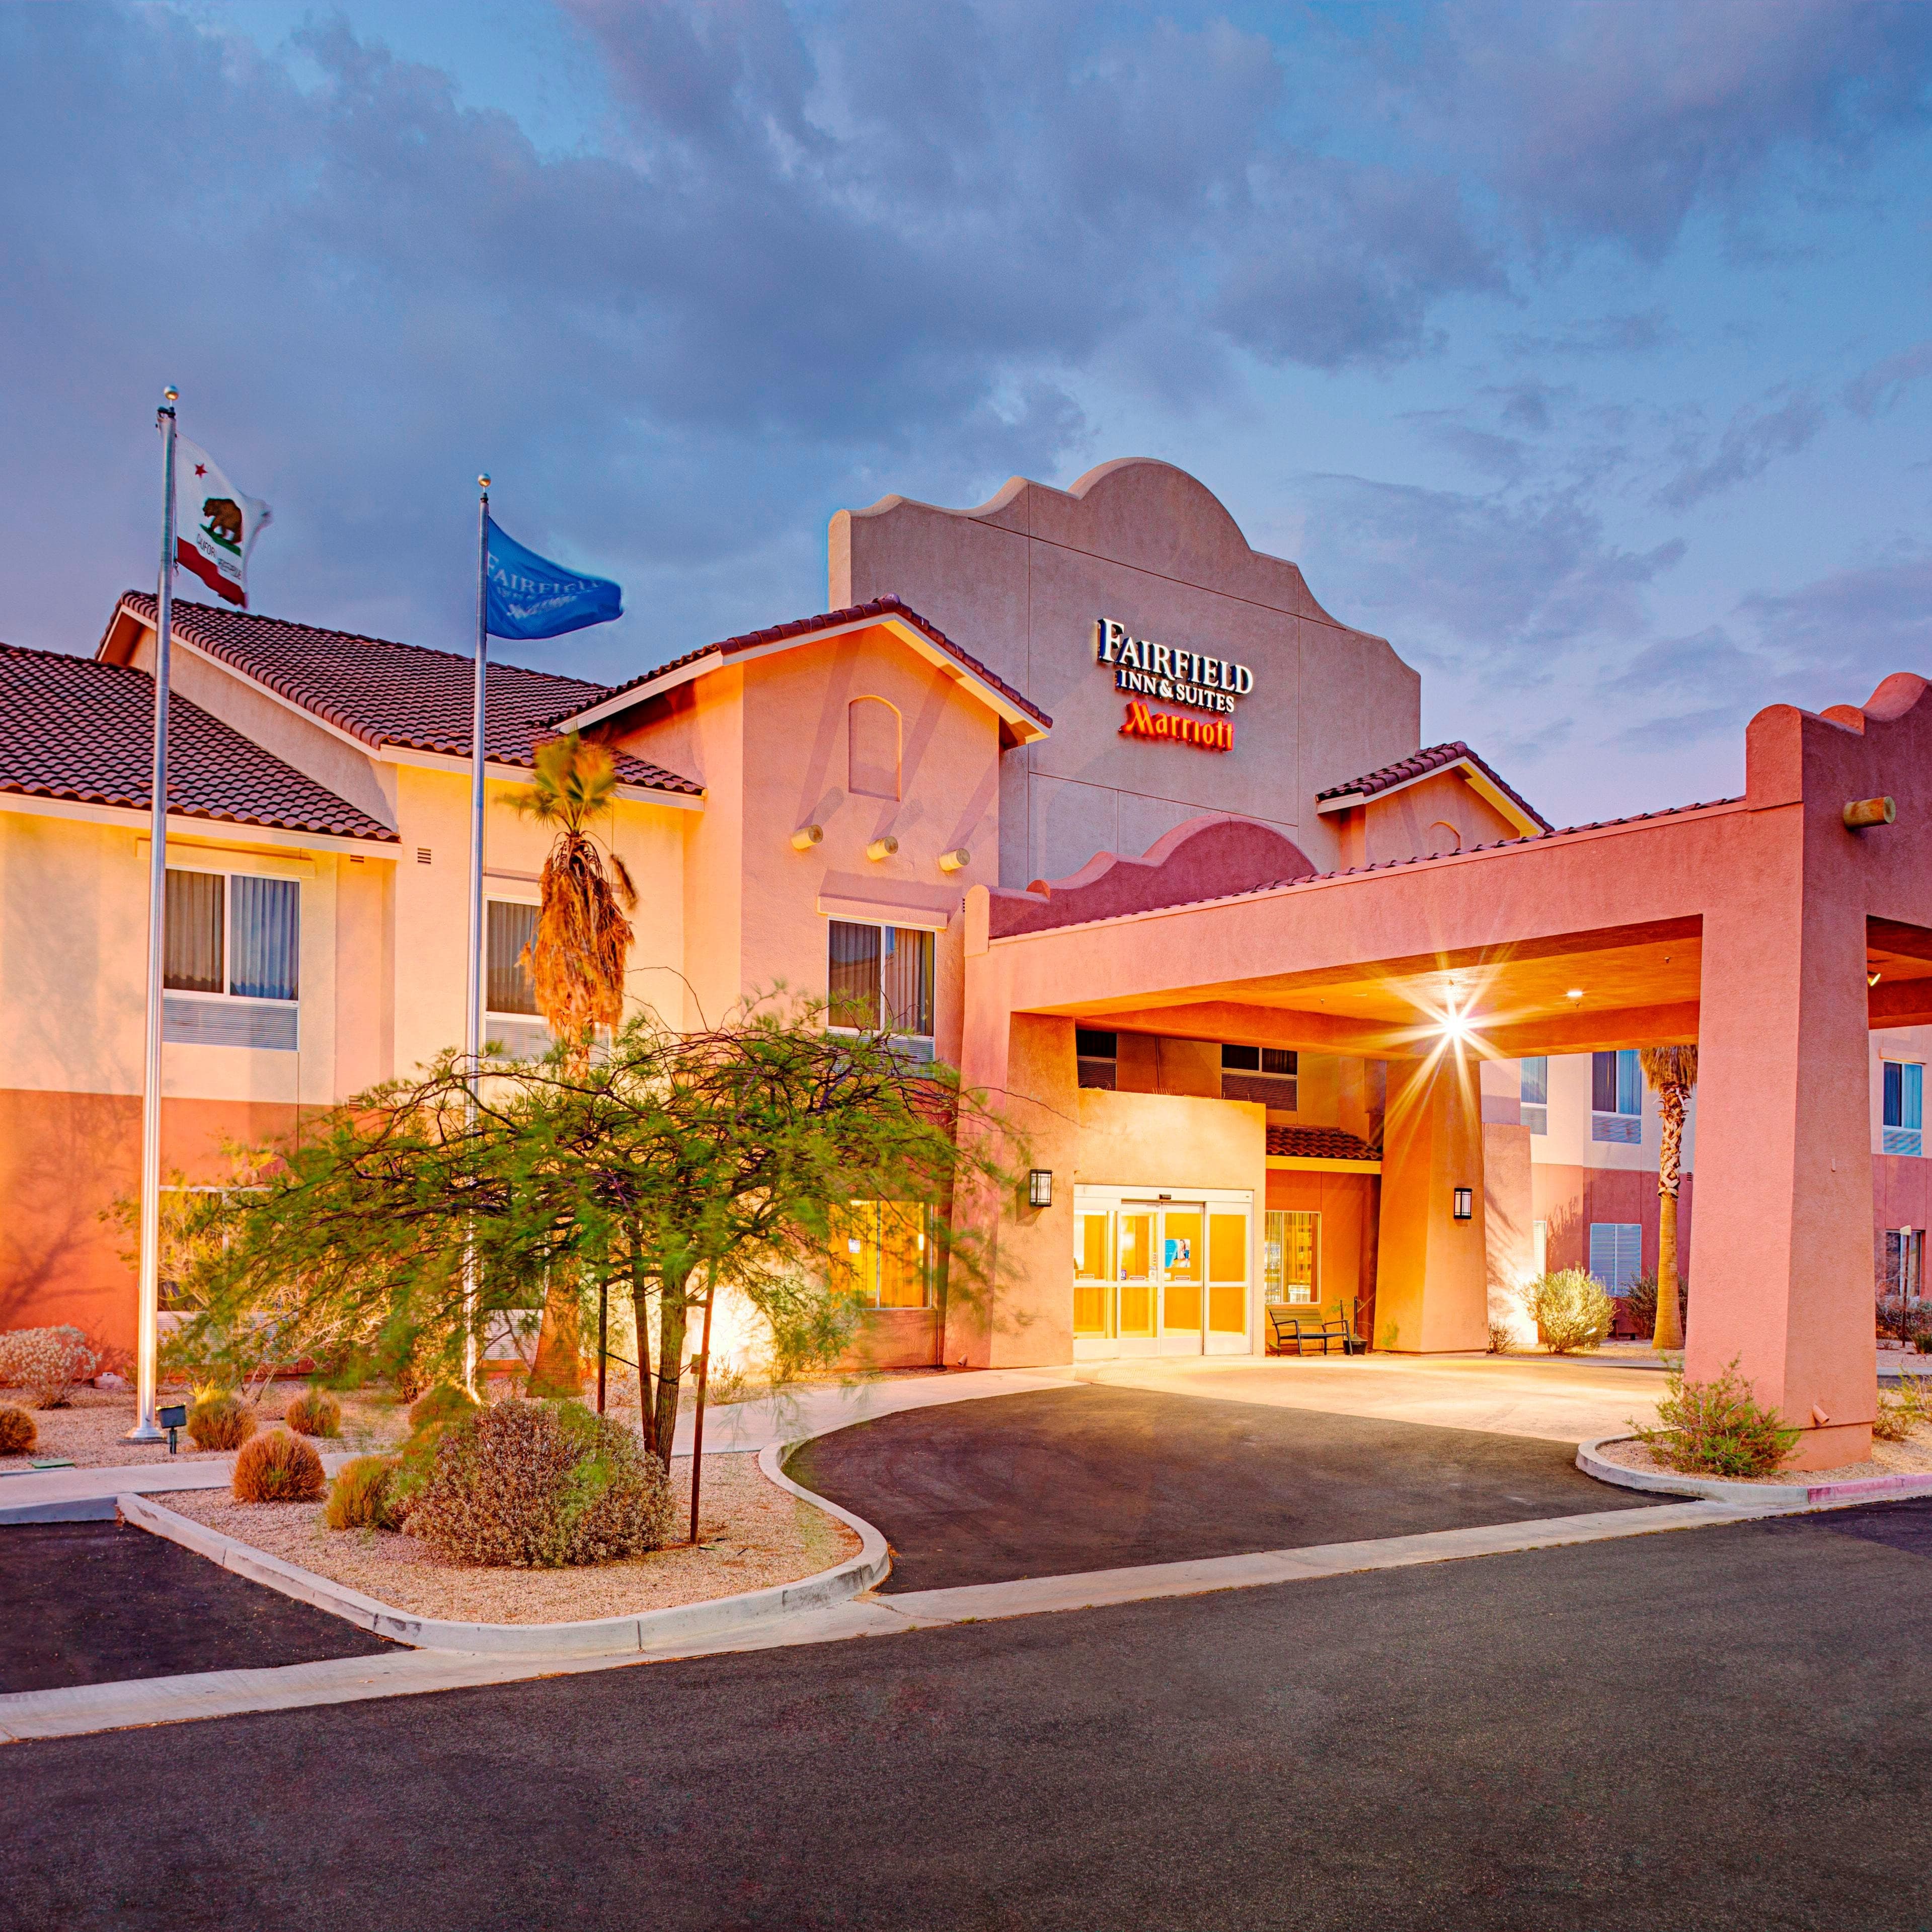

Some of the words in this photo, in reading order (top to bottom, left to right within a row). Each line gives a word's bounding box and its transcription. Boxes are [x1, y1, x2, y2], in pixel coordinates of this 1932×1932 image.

[1098, 619, 1253, 694] FAIRFIELD
[1116, 669, 1156, 694] INN
[1176, 683, 1234, 713] SUITES
[1119, 701, 1233, 751] Marriott
